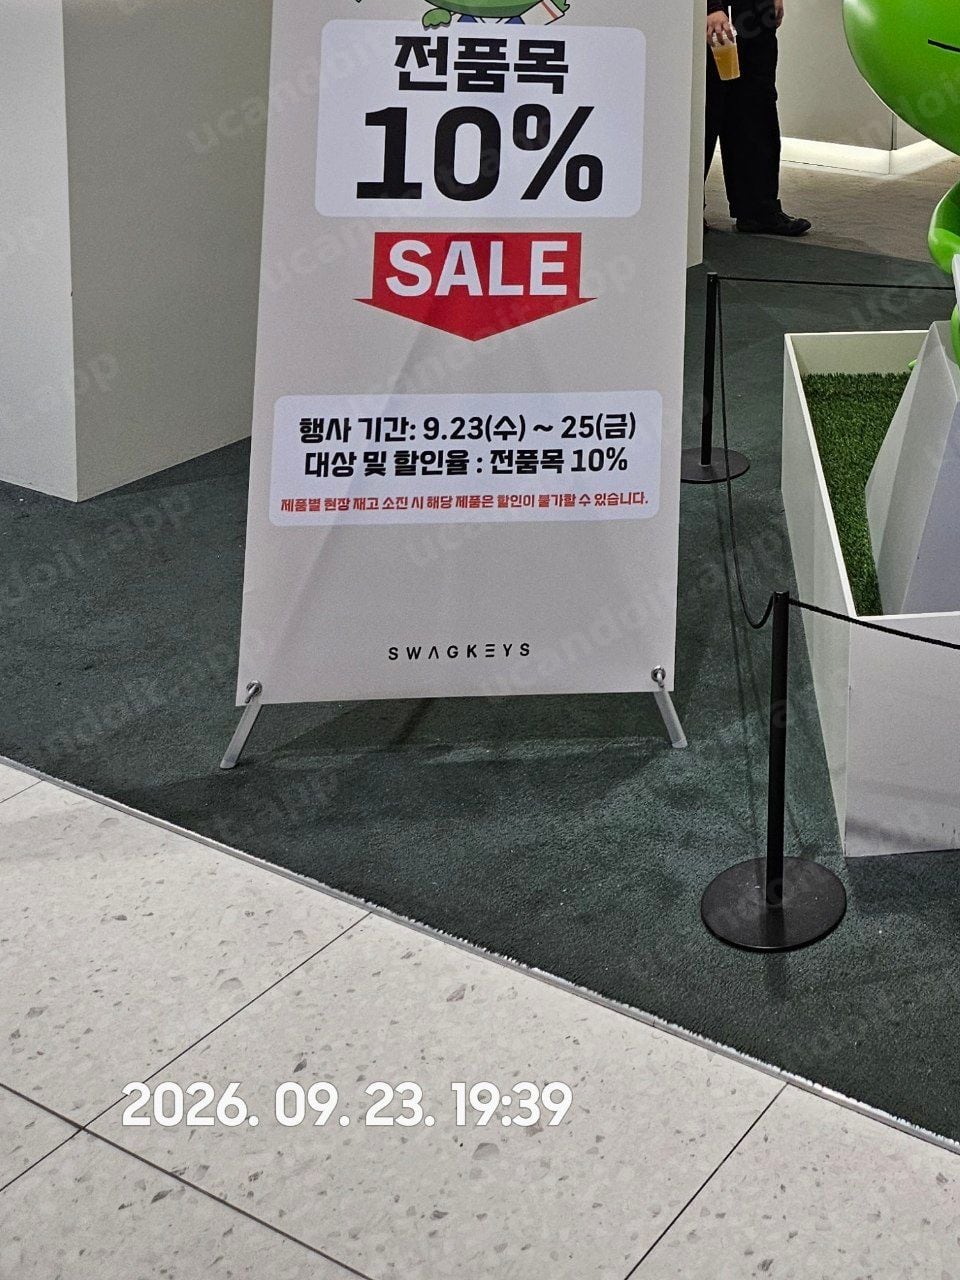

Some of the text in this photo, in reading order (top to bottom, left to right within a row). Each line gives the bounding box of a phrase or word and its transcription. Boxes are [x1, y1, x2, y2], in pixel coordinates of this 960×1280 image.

[394, 36, 569, 95] 전품목
[356, 103, 603, 202] 10%
[385, 239, 568, 297] SALE
[300, 418, 352, 443] 행사
[358, 417, 416, 442] 기간:
[423, 414, 526, 442] 9.23(수)
[561, 412, 636, 440] 25(금)
[304, 452, 357, 477] 대상
[363, 451, 387, 476] 및
[394, 449, 470, 476] 할인율
[490, 448, 565, 474] 전품목
[570, 446, 628, 472] 10%
[281, 491, 649, 512] 제품별 현장 재고 소진 시 해당 제품은 할인이 불가할 수 있습니다.
[388, 642, 530, 662] SWAGKEYS
